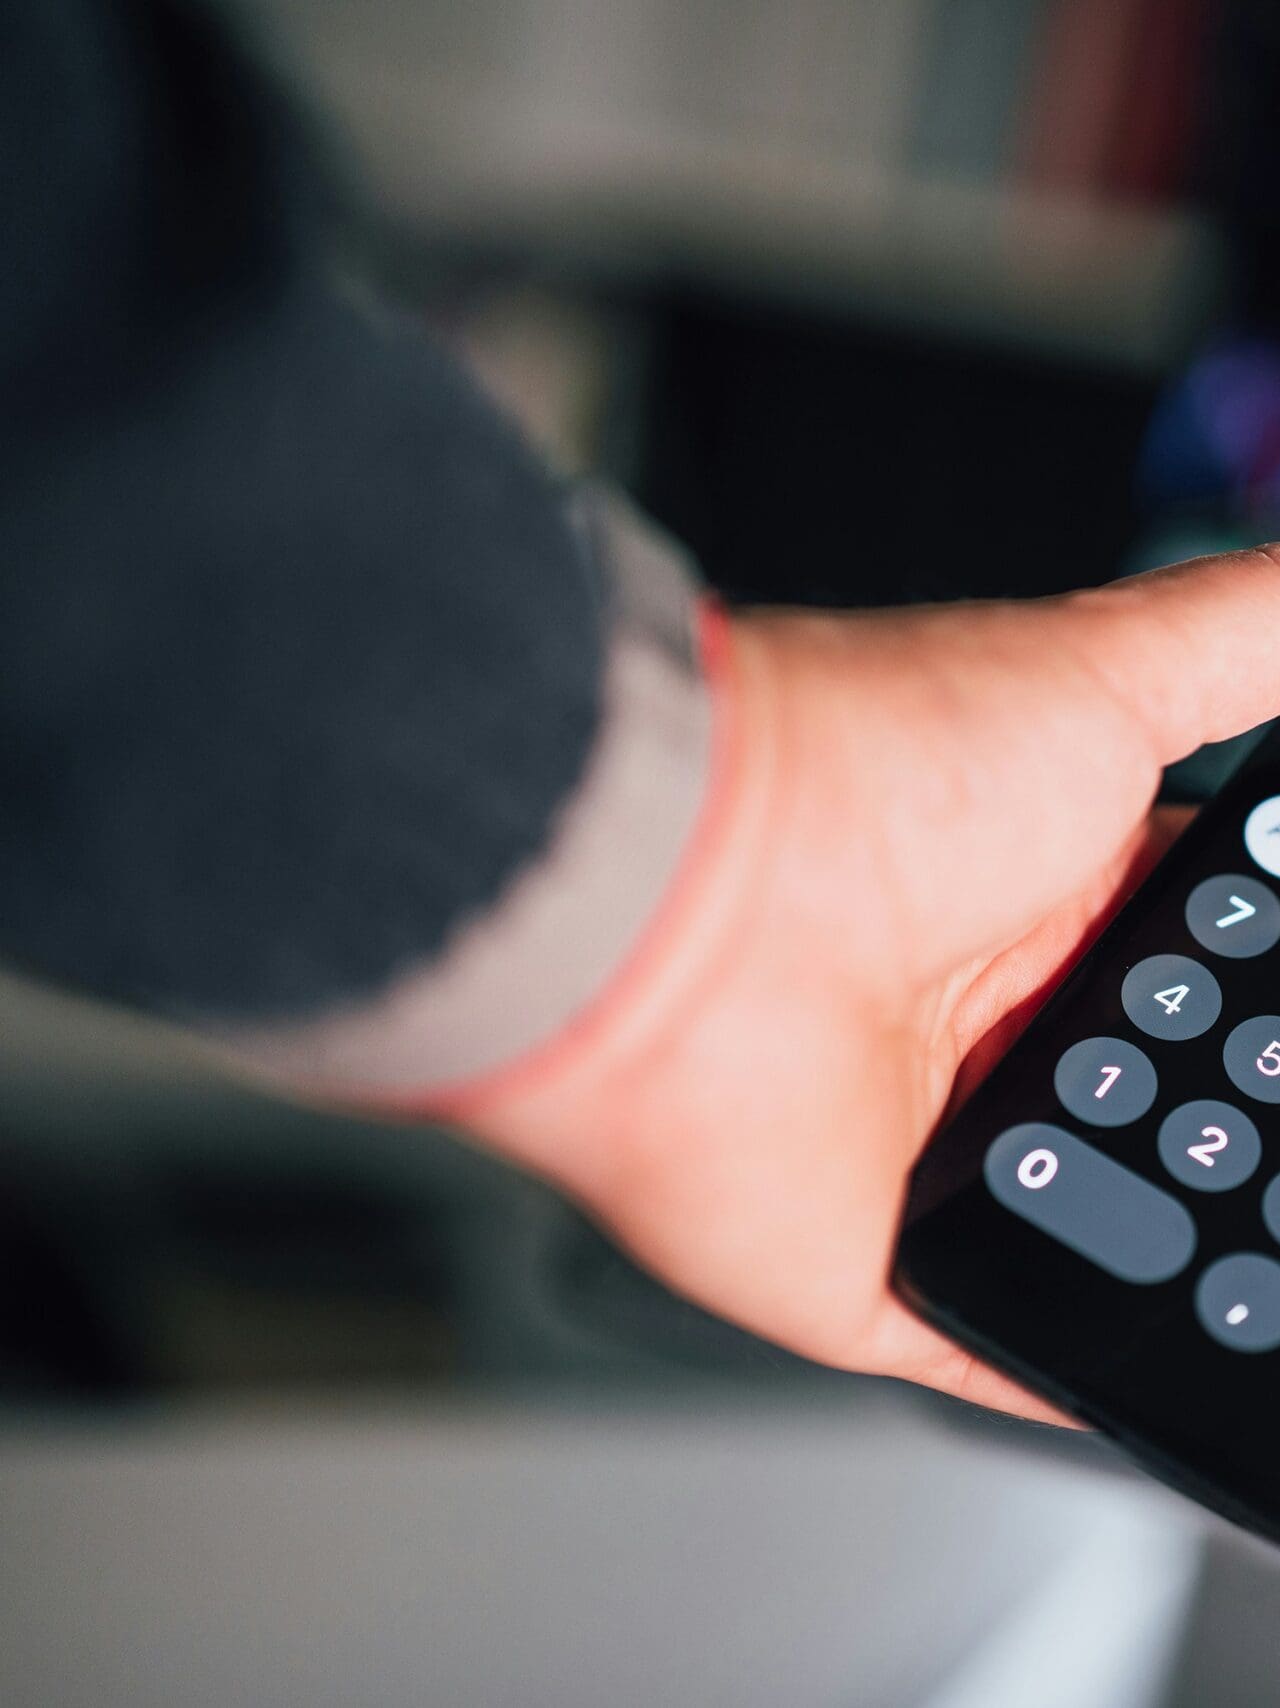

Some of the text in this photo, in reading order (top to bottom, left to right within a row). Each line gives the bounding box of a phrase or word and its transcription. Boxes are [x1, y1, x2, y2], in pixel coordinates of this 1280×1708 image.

[1216, 896, 1255, 927] 7
[1154, 985, 1189, 1014] 4
[1095, 1067, 1121, 1098] 1
[1187, 1127, 1228, 1166] 2
[1018, 1149, 1058, 1189] 0
